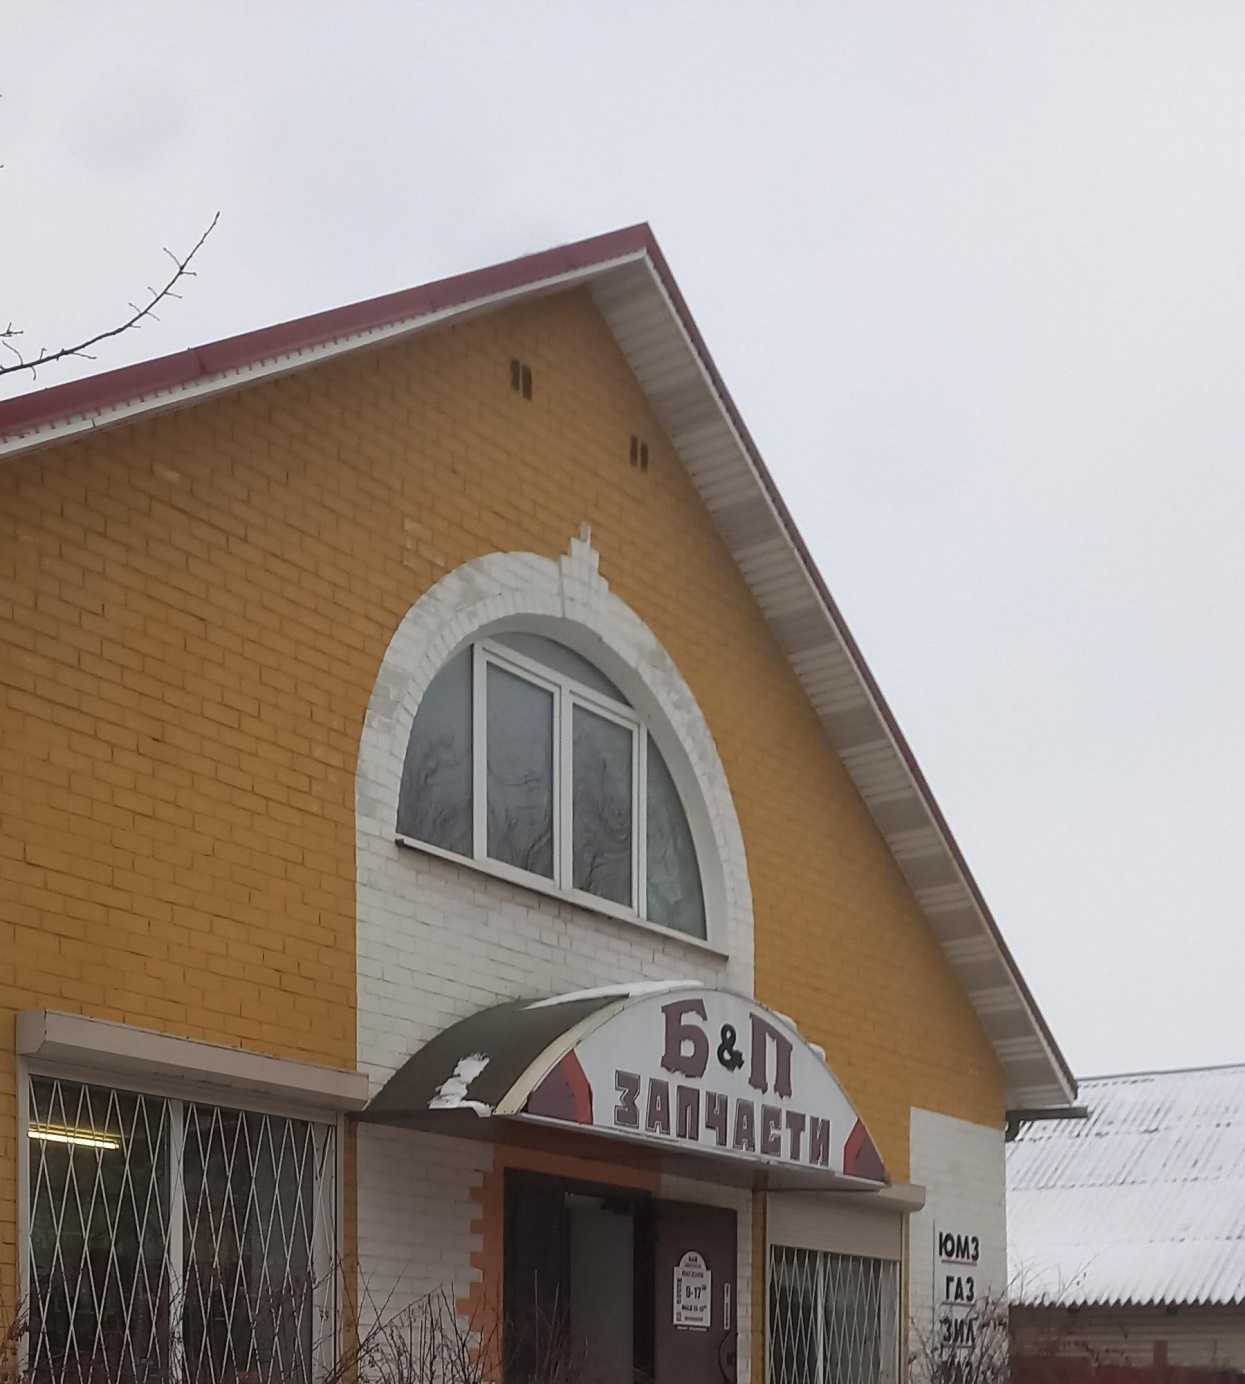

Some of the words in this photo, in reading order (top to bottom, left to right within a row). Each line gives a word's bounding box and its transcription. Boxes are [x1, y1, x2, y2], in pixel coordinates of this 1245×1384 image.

[614, 1069, 831, 1167] ЗАПЧАСТИ
[938, 1231, 980, 1261] ЮМЗ
[945, 1275, 975, 1302] ГАЗ
[942, 1317, 976, 1344] ЗИЛ
